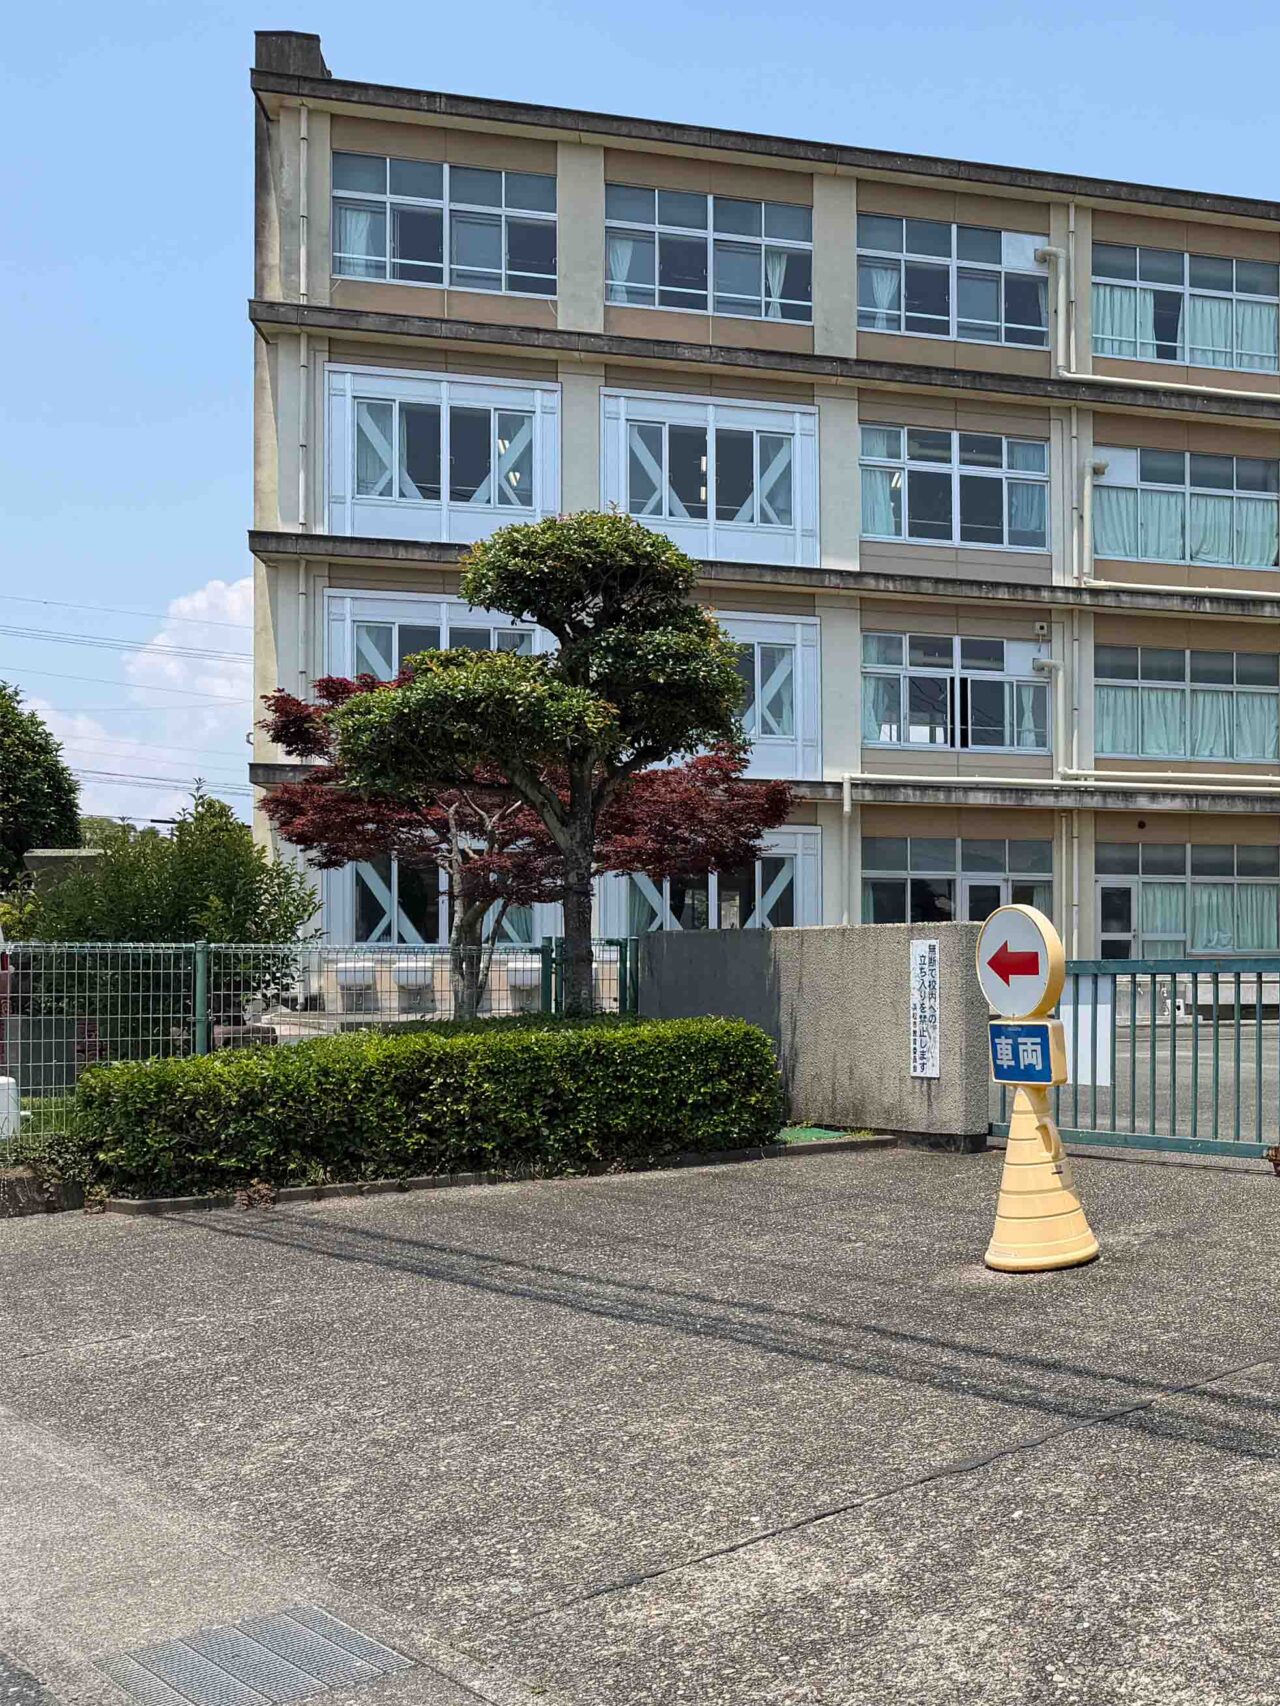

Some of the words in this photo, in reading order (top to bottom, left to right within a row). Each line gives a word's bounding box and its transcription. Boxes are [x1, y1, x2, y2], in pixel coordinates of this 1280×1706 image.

[919, 954, 928, 1073] 立ち入りを禁止します
[928, 944, 937, 1024] 無断で校内への
[995, 1036, 1042, 1071] 車両
